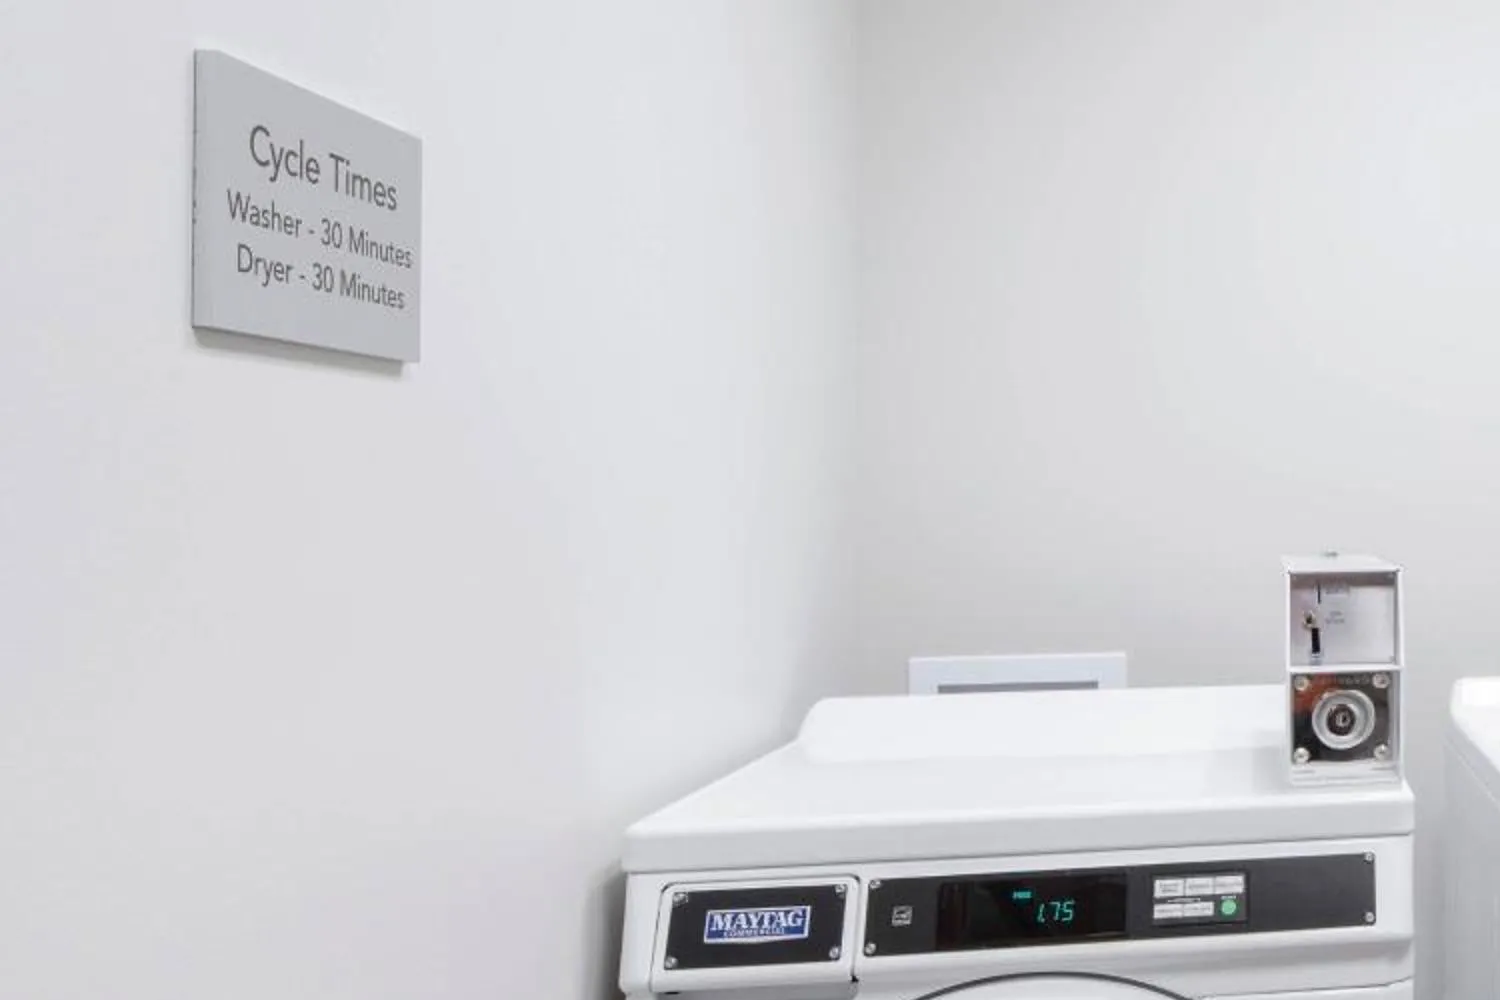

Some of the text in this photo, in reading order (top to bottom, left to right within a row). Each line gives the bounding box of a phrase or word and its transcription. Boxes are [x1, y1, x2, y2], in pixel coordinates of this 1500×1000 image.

[249, 124, 398, 211] Cycle Times
[226, 188, 303, 238] Washer
[320, 218, 343, 249] 30
[348, 225, 413, 269] Minutes
[237, 243, 294, 287] Dryer
[311, 262, 335, 294] 30
[339, 269, 406, 310] Minutes
[710, 911, 804, 930] MAYTAG
